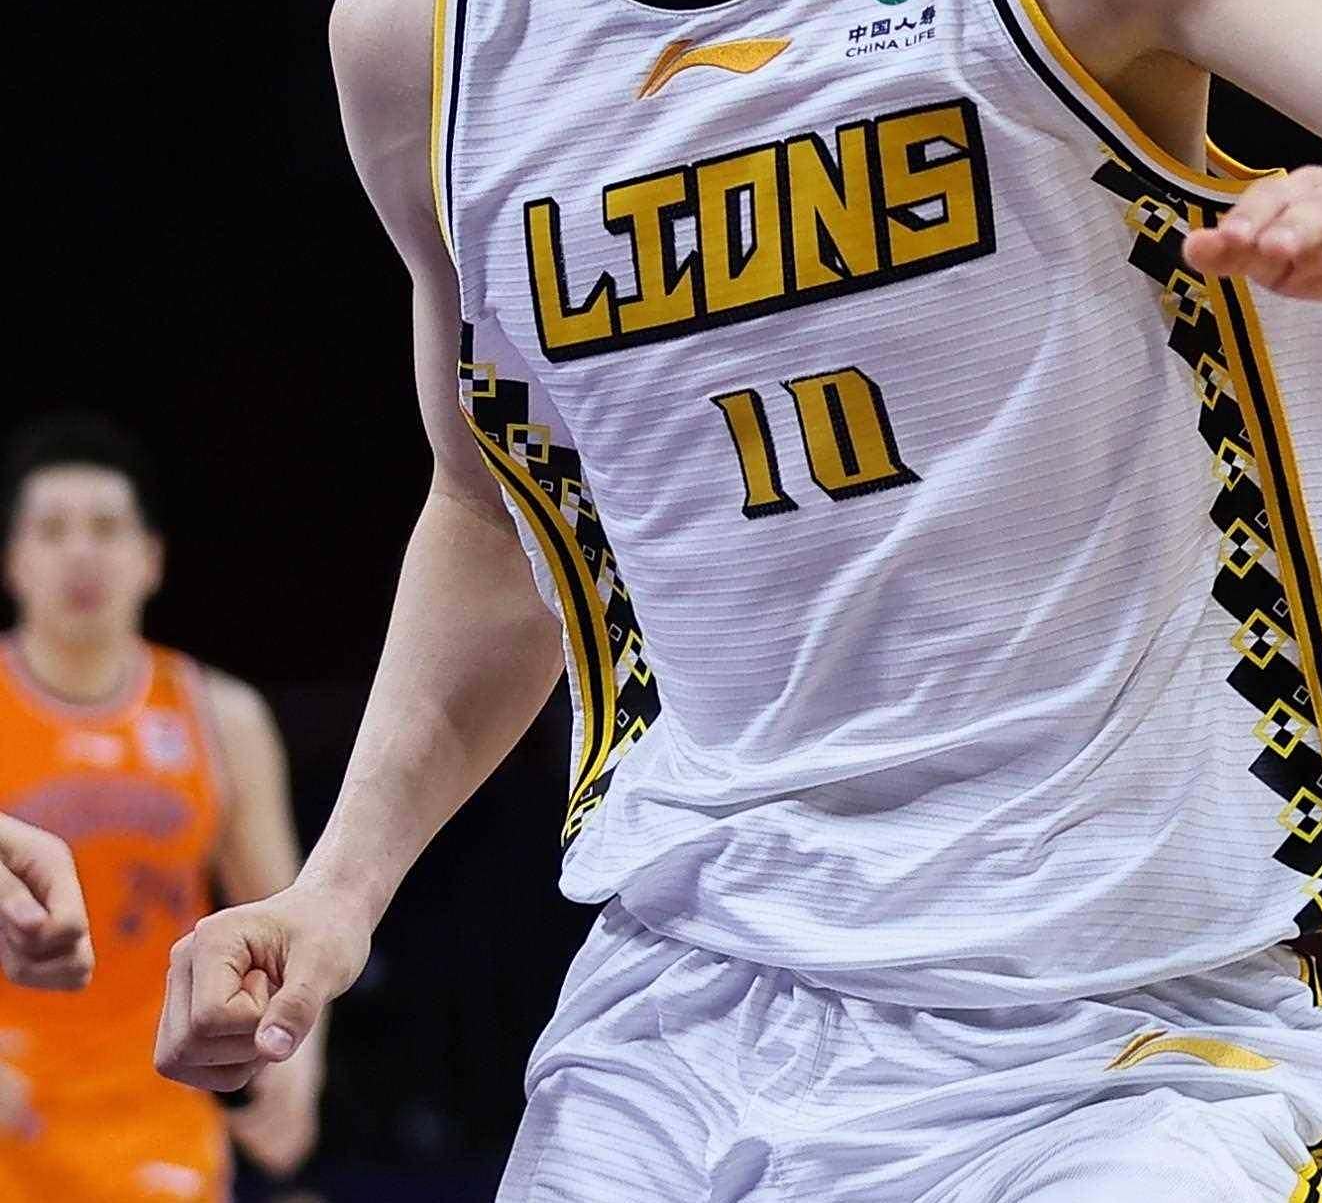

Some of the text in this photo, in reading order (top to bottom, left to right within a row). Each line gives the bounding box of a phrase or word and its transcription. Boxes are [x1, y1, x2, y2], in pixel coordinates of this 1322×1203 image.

[846, 28, 936, 58] CHINA LIFE
[848, 5, 936, 44] 中国人寿
[524, 97, 997, 363] LIONS
[710, 366, 923, 520] 10
